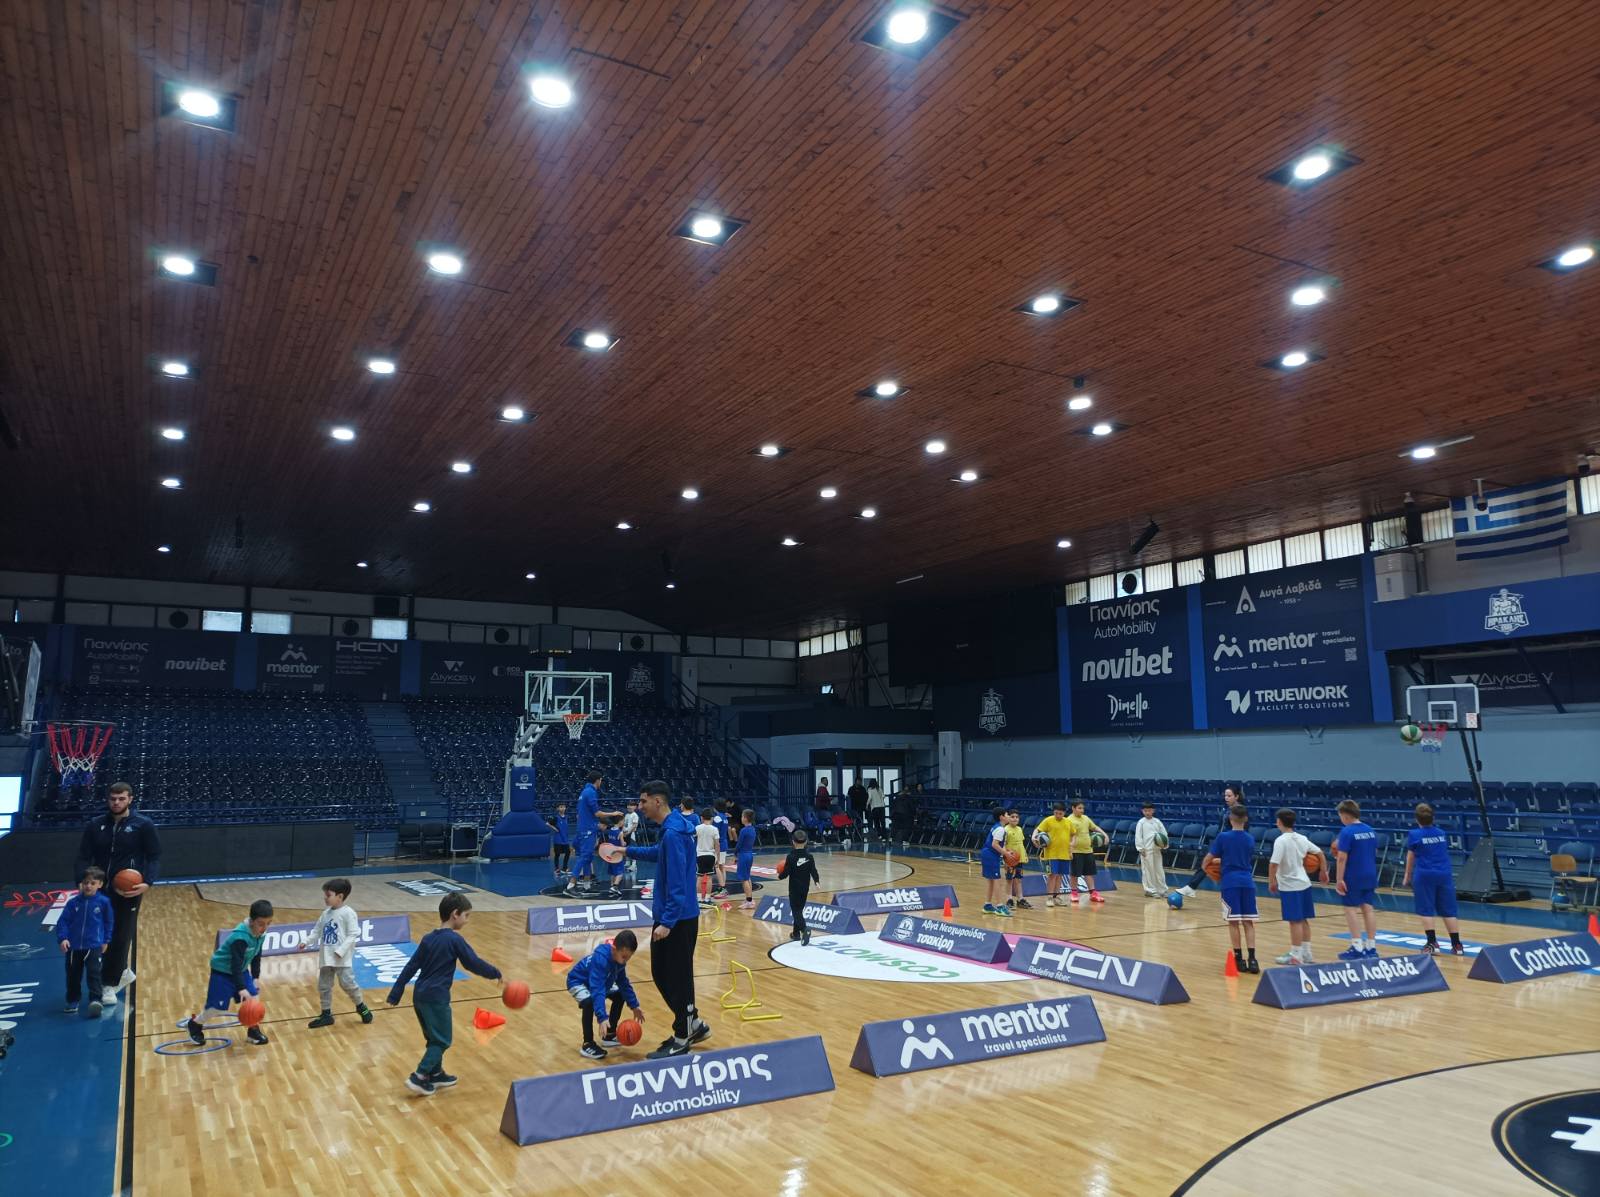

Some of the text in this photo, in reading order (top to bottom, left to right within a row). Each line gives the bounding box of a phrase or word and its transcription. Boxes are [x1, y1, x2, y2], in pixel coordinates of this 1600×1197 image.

[1259, 584, 1284, 599] Αυγά
[1285, 578, 1323, 595] Λαβιδά
[1089, 598, 1160, 623] Γιαννίρης
[1094, 620, 1157, 640] AutoMobility
[84, 638, 150, 653] Γιαννίρης
[335, 640, 398, 654] HCN
[1248, 631, 1316, 653] mentor
[165, 657, 227, 672] novibet
[266, 663, 320, 674] mentor
[1081, 645, 1174, 682] novibet
[1254, 685, 1349, 704] TRUEWORK
[1256, 701, 1351, 712] FACILITY SOLUTIONS
[874, 888, 921, 905] nolte
[558, 925, 589, 933] Redefine
[916, 933, 955, 952] τσακίρη
[1031, 942, 1143, 987] HCN
[1509, 938, 1592, 977] Condito
[1027, 966, 1055, 978] Redefine
[1318, 955, 1420, 988] Αυγά Λαβιδά
[960, 1002, 1069, 1042] mentor
[984, 1033, 1067, 1054] travel specialists
[582, 1053, 772, 1105] Γιαννίρης
[630, 1089, 741, 1121] Automobility
